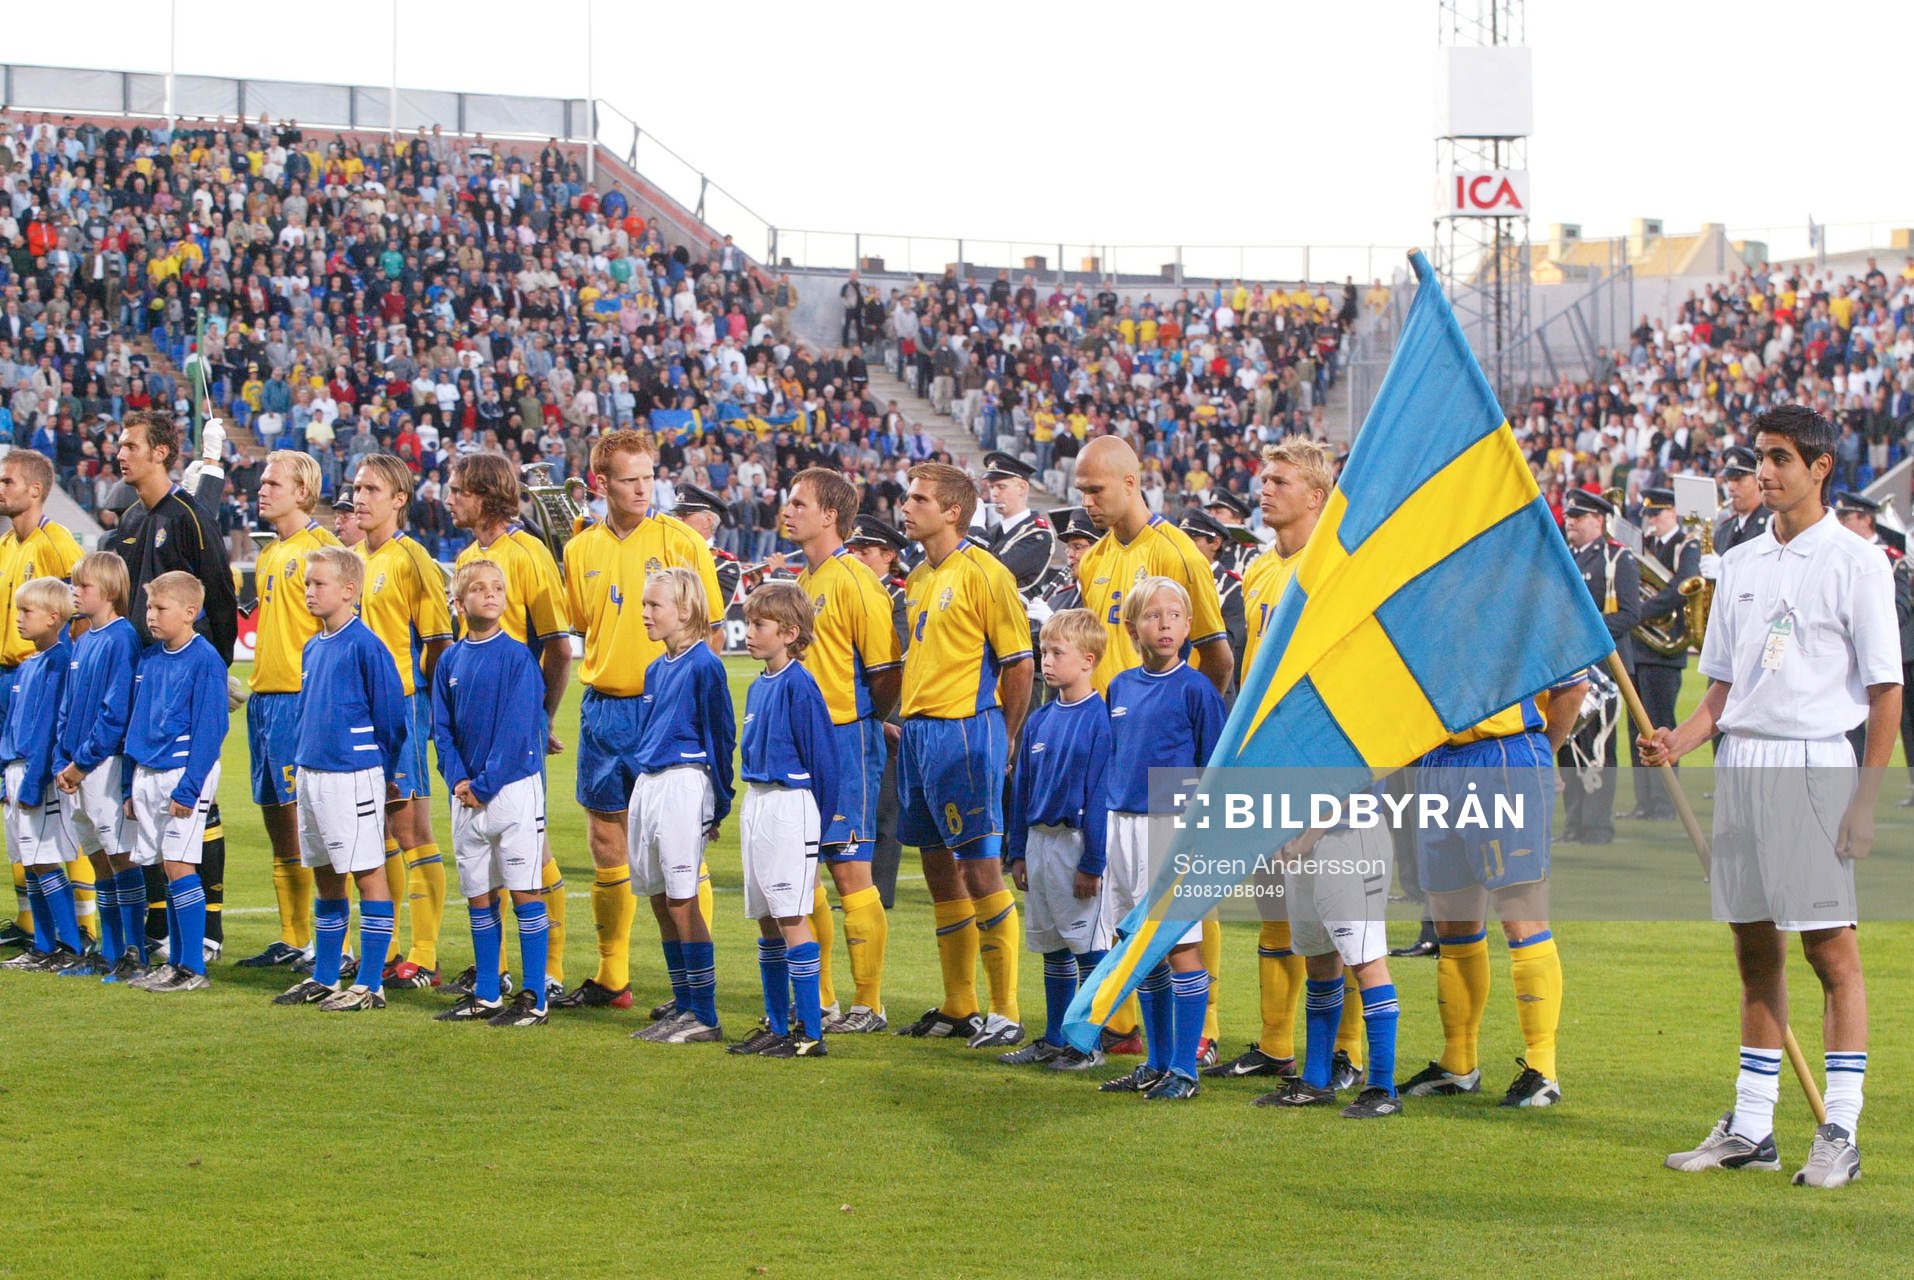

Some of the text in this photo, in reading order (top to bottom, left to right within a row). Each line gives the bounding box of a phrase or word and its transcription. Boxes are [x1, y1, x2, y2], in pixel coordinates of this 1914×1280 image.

[1456, 175, 1523, 209] ICA
[610, 584, 624, 615] 4
[282, 764, 297, 794] 5
[944, 802, 964, 835] 8
